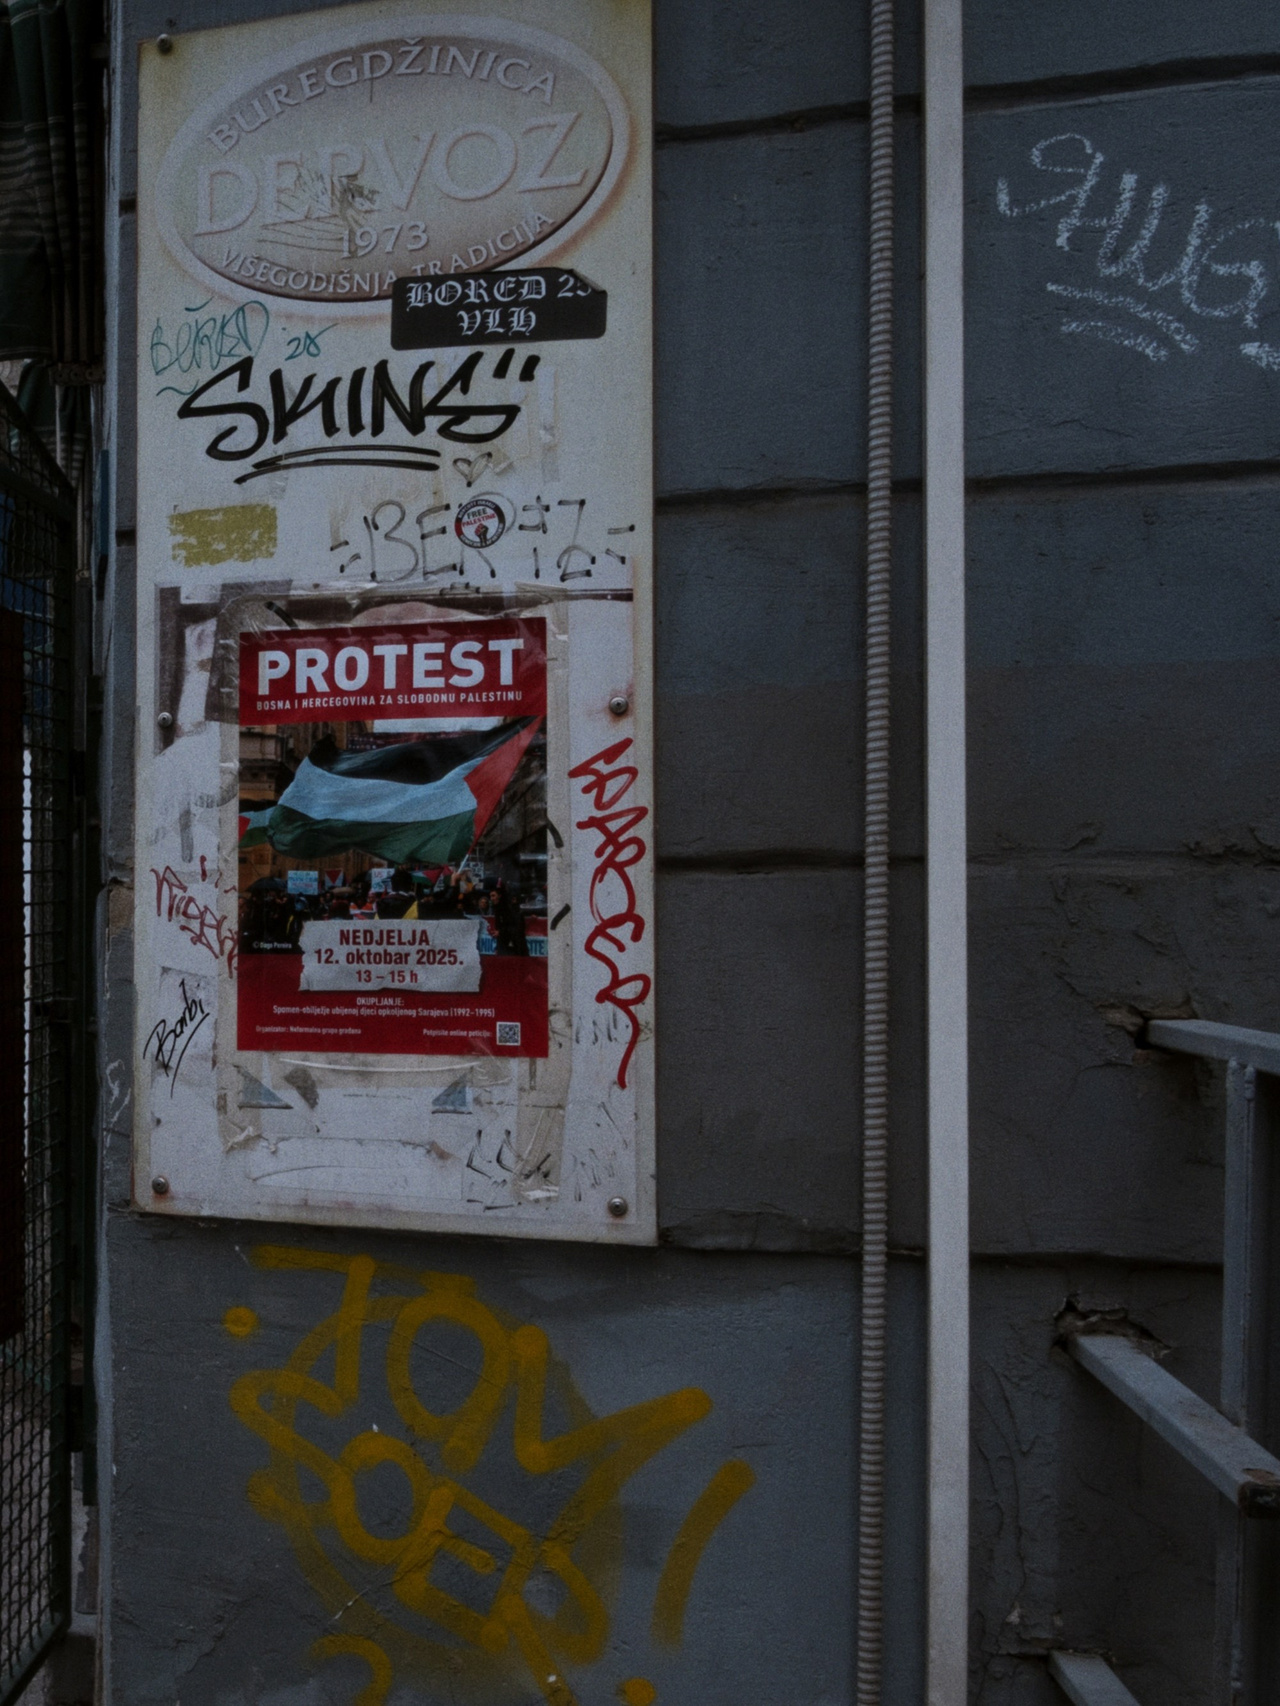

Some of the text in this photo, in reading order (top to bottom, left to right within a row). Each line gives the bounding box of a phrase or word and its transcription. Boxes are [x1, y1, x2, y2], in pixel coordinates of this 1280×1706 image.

[206, 37, 557, 156] BUREGDŽINICA
[194, 111, 593, 237] DERVOZ
[340, 219, 430, 260] 1973
[220, 211, 556, 297] VIŠEGODIŠNJA TRADICIJA
[406, 275, 546, 312] BORED
[457, 306, 537, 336] VLH
[462, 513, 496, 527] PALESTINE
[467, 508, 487, 519] FREE
[258, 638, 524, 696] PROTEST
[257, 701, 291, 711] BOSNA
[302, 696, 376, 709] HERCEGOVINA
[380, 695, 393, 704] ZA
[397, 693, 456, 704] SLOBODNU
[460, 691, 523, 703] PALESTINU
[339, 929, 430, 946] NEDJELJA
[314, 949, 464, 965] 12. oktobar 2025.
[356, 970, 372, 983] 13
[389, 970, 405, 983] 15
[410, 970, 418, 983] h
[356, 997, 404, 1006] OKUPLJANJE:
[273, 1005, 329, 1015] Spomen-obilježje
[332, 1006, 358, 1016] ubijenoj
[360, 1007, 376, 1016] djeci
[378, 1007, 416, 1017] opkoljenog
[418, 1008, 448, 1017] Sarajeva
[256, 1025, 288, 1034] Organizator:
[450, 1029, 467, 1037] online
